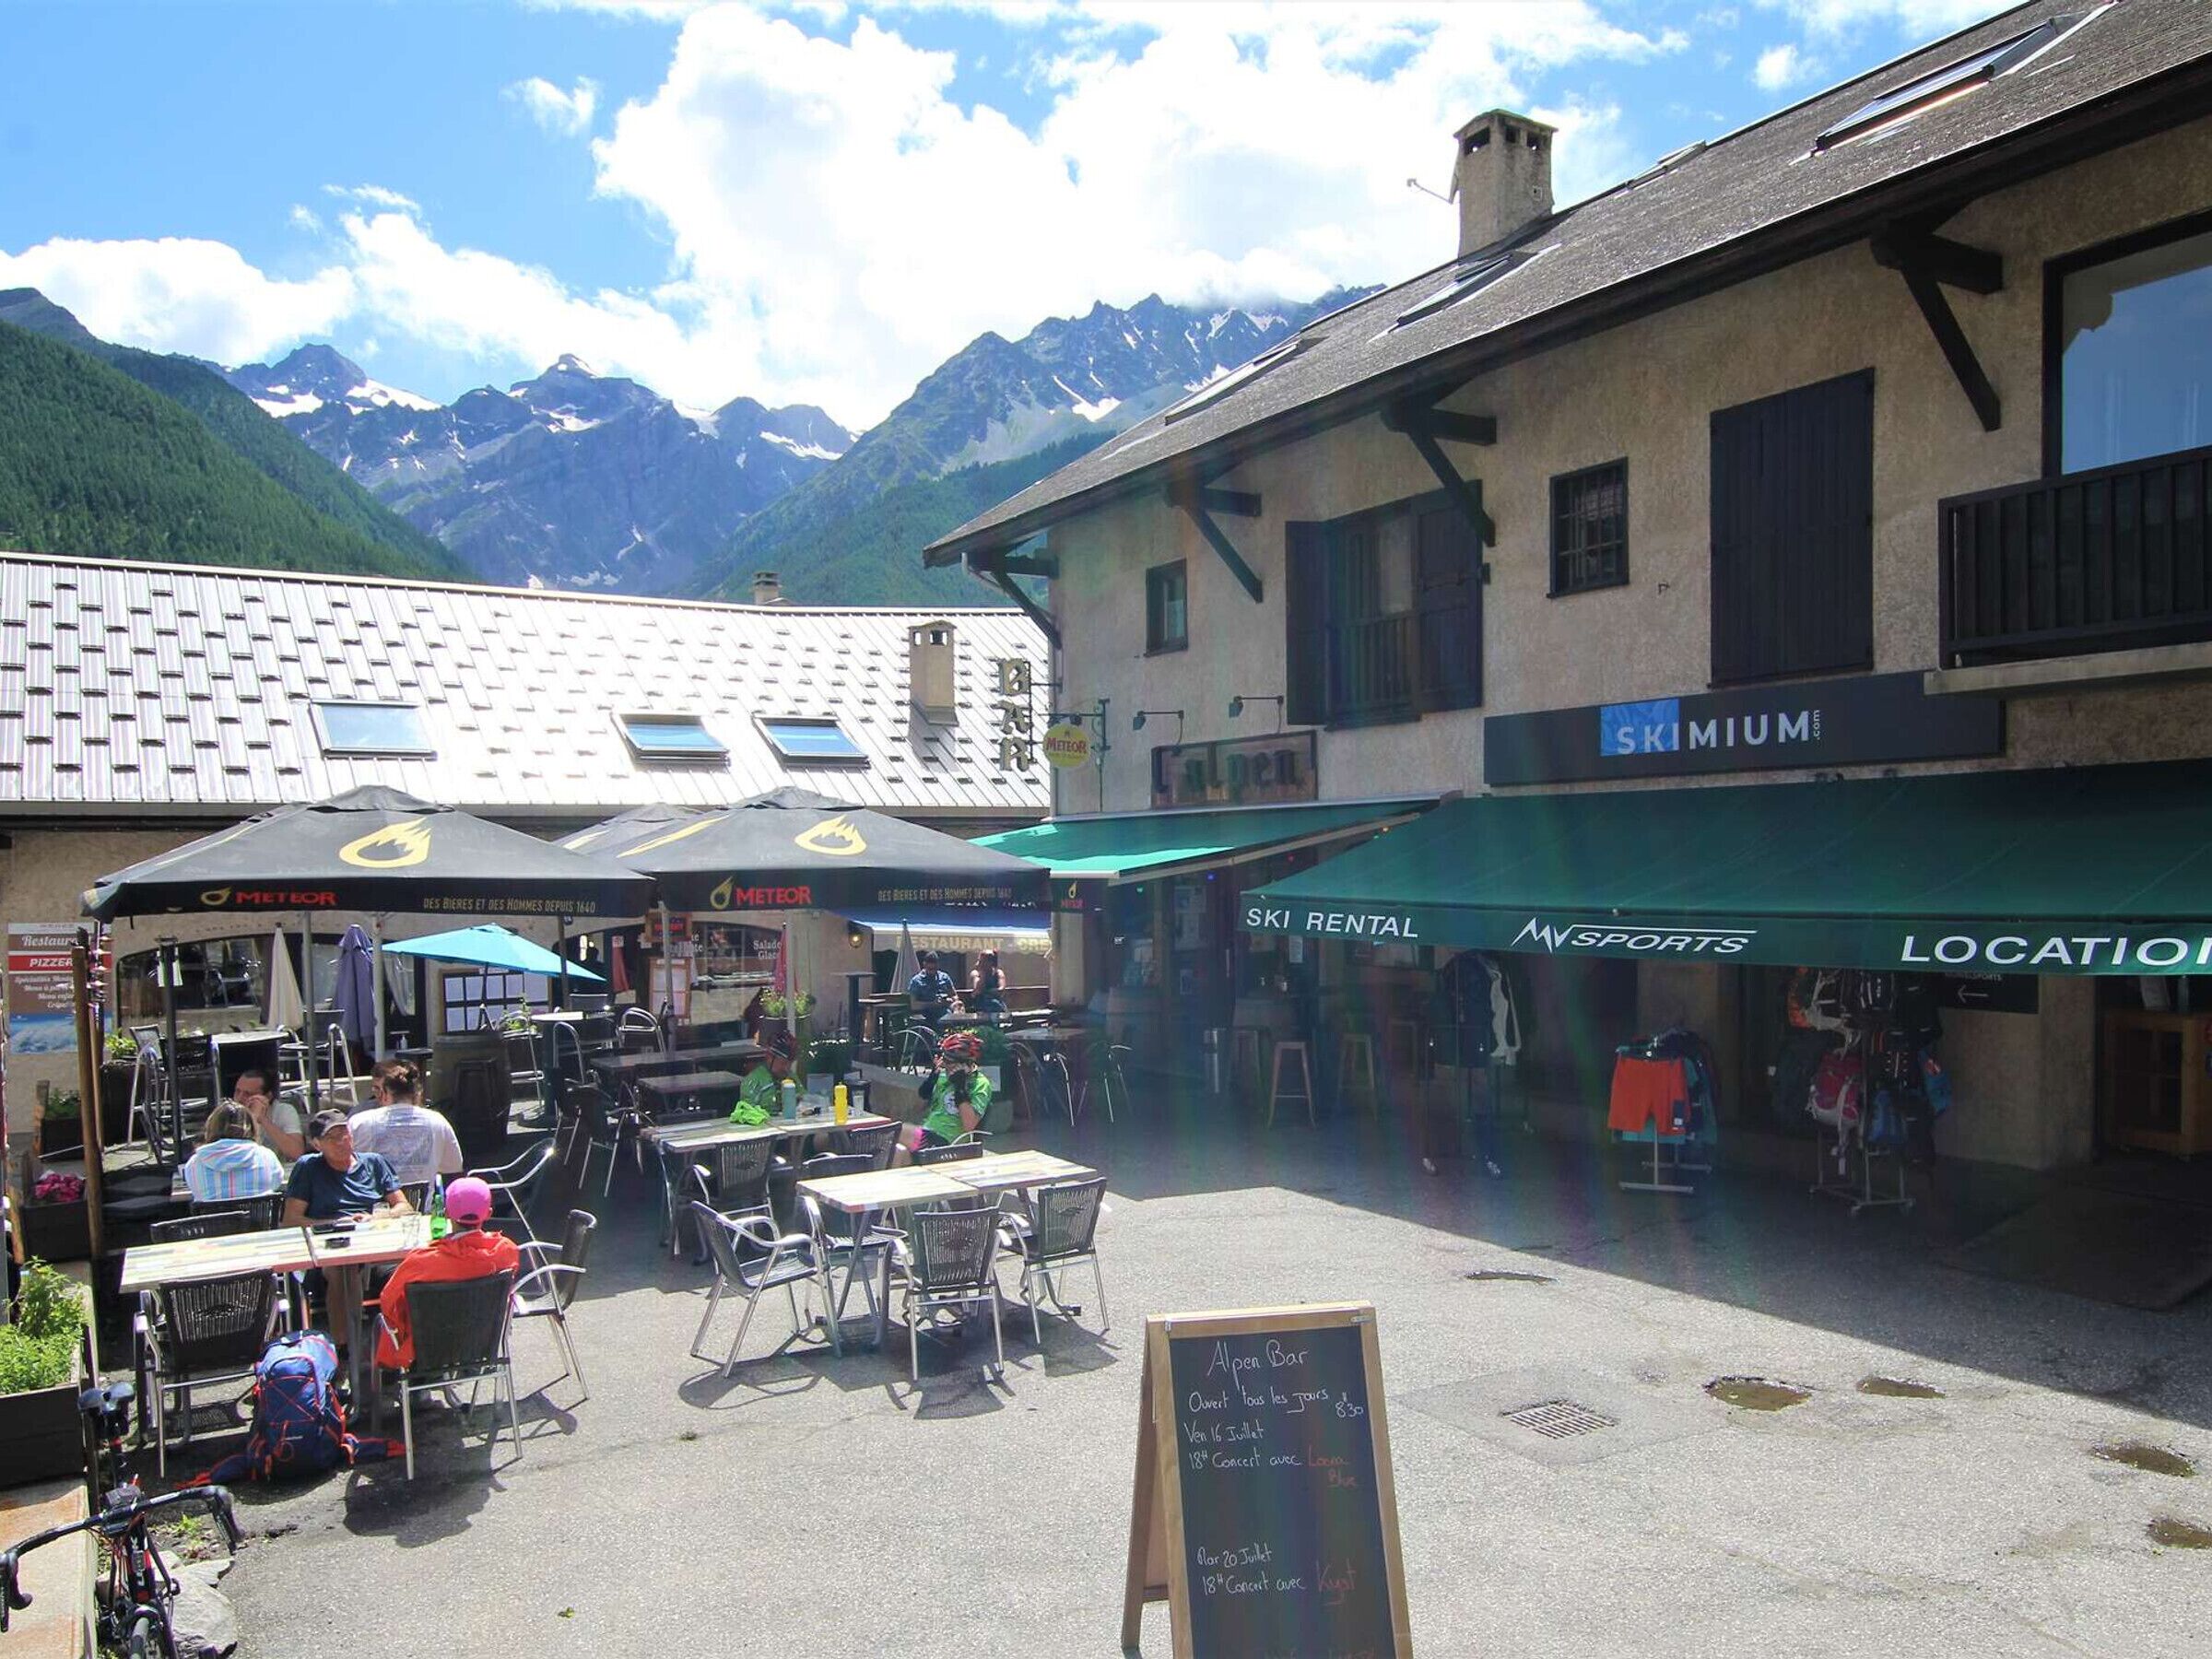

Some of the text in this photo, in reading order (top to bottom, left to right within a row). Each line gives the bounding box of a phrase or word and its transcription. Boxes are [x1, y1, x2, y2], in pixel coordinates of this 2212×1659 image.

[997, 658, 1031, 771] BAR
[1617, 711, 1809, 754] SKIMIUM
[1046, 737, 1087, 754] METEOR
[236, 891, 337, 905] METEOR
[735, 886, 811, 905] METEOR
[919, 888, 928, 900] ET
[423, 898, 440, 910] DES
[476, 898, 486, 911] ET
[488, 899, 506, 911] DES
[507, 898, 543, 912] HOMMES
[545, 900, 573, 912] DEPUIS
[576, 900, 596, 913] 1640
[1246, 908, 1418, 938] SKI RENTAL
[21, 935, 77, 947] Restaura
[1017, 937, 1053, 951] CRE
[1571, 932, 1749, 953] SPORTS
[29, 959, 74, 968] PIZZER
[758, 951, 780, 960] Glac
[1207, 1339, 1309, 1391] Alpen Bar
[1189, 1391, 1229, 1413] Ouvert
[1241, 1385, 1265, 1407] tous
[1270, 1386, 1288, 1406] les
[1183, 1419, 1265, 1442] Ven 16 Juillet
[1212, 1447, 1260, 1468] Concert
[1269, 1453, 1301, 1466] avec
[1222, 1550, 1238, 1568] 20
[1238, 1542, 1272, 1565] Juillet
[1226, 1571, 1269, 1594] Concert
[1276, 1577, 1306, 1592] avec
